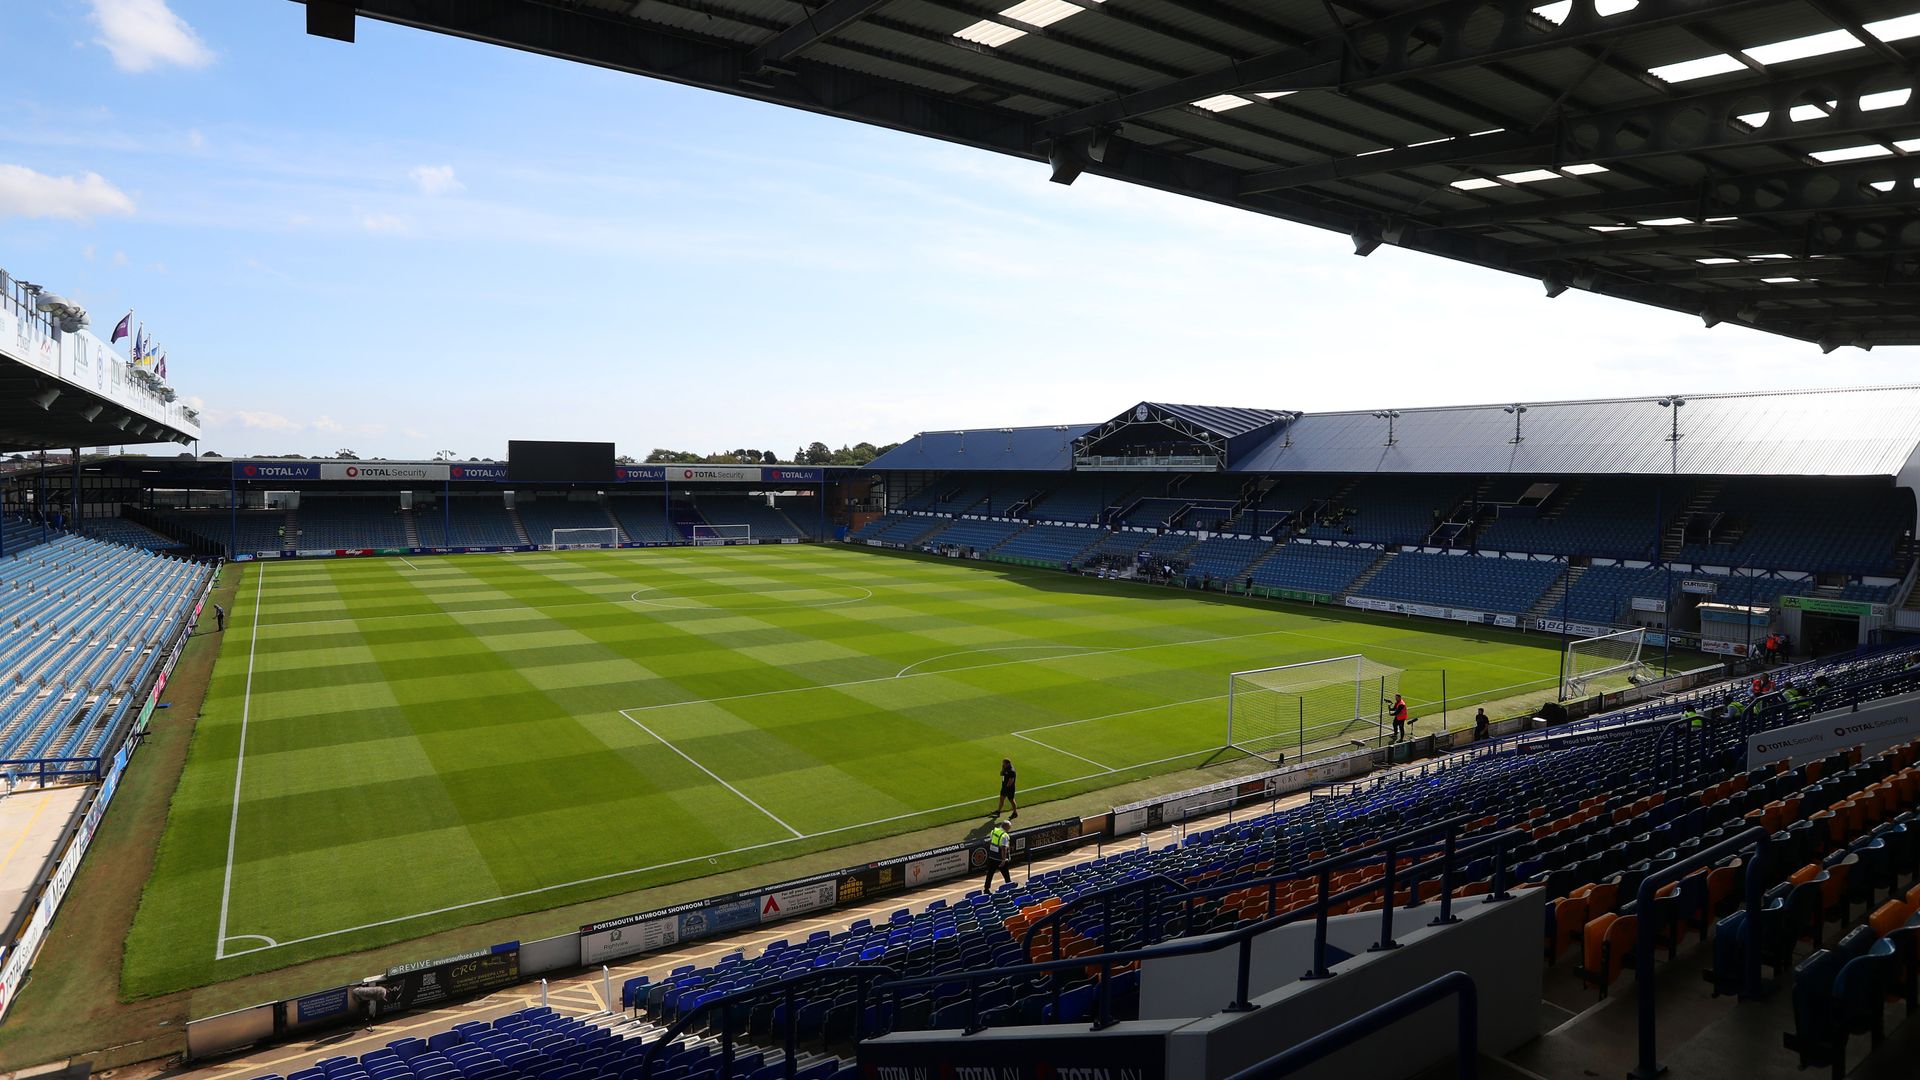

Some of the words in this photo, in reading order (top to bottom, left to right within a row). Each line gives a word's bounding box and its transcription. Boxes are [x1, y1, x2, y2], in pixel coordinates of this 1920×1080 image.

[259, 467, 294, 476] TOTAL
[295, 468, 310, 476] AV
[464, 468, 494, 478] TOTAL
[627, 470, 652, 478] TOTAL
[1845, 722, 1875, 733] TOTAL
[1875, 716, 1909, 728] Security
[1562, 737, 1579, 745] Proud
[1587, 733, 1608, 741] Protect
[1766, 740, 1793, 750] TOTAL
[1794, 732, 1824, 745] Security
[878, 855, 908, 867] PORTSMOUTH
[908, 850, 932, 861] BATHROOM
[933, 844, 959, 856] SHOWROOM
[593, 916, 634, 930] PORTSMOUTH
[635, 909, 667, 923] BATHROOM
[668, 901, 703, 914] SHOWROOM
[399, 959, 431, 973] REVIVE
[433, 948, 488, 966] revivesouthsea.co.uk
[451, 960, 477, 978] CRG
